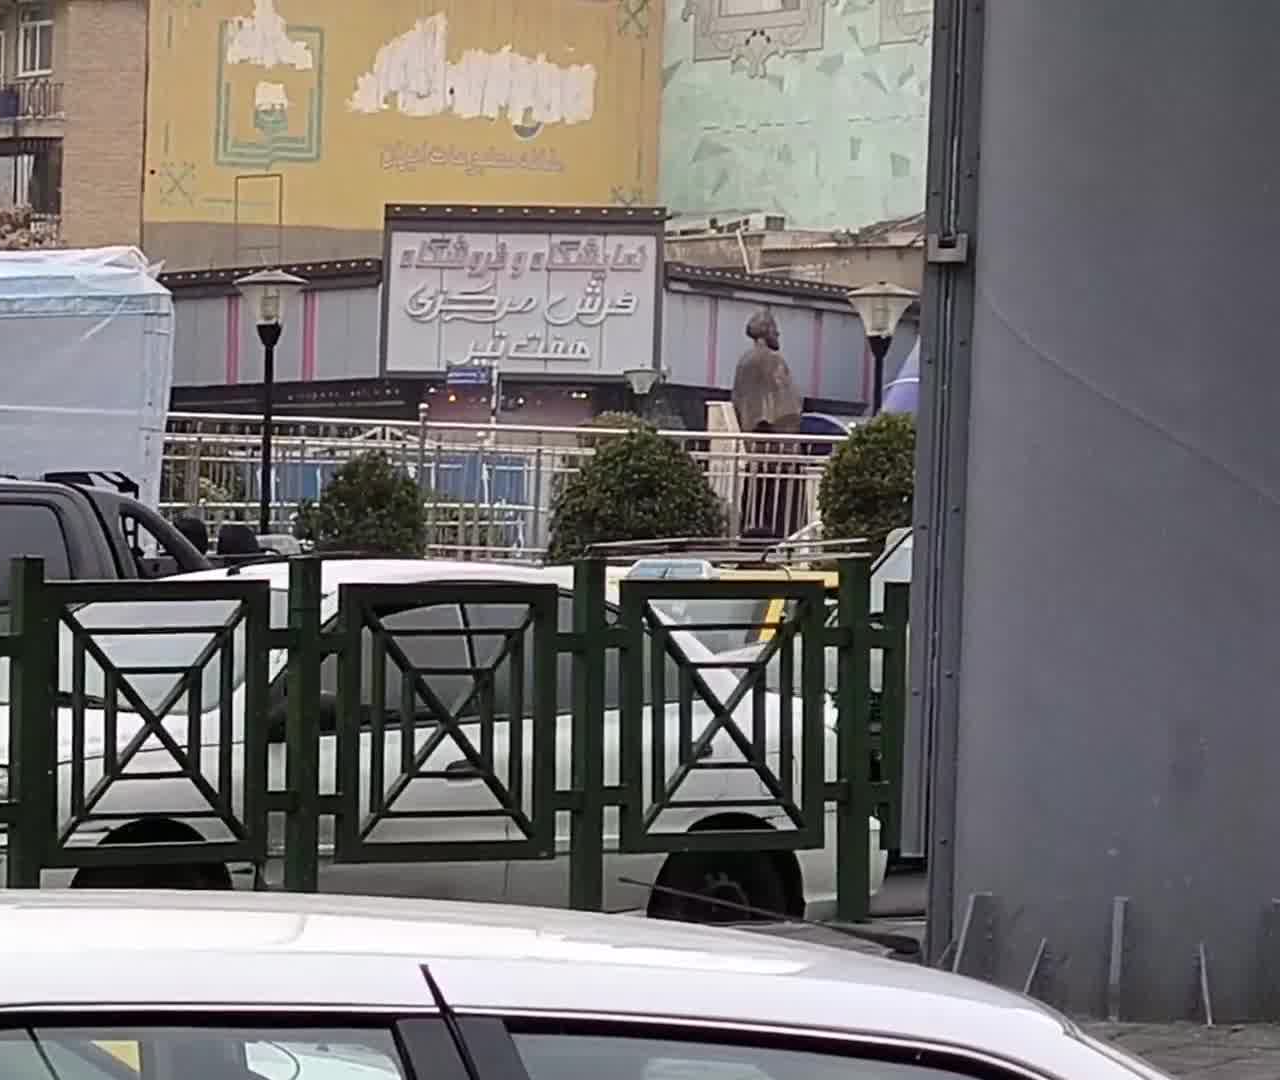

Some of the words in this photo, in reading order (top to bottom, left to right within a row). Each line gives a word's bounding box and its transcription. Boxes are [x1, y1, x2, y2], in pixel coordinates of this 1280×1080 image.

[400, 236, 507, 279] فروشگاه
[510, 248, 529, 281] و
[529, 237, 647, 273] نمایشگاه
[404, 279, 538, 324] مرکزی
[544, 278, 639, 326] فرش
[448, 328, 508, 367] تیر
[507, 334, 592, 361] هفت
